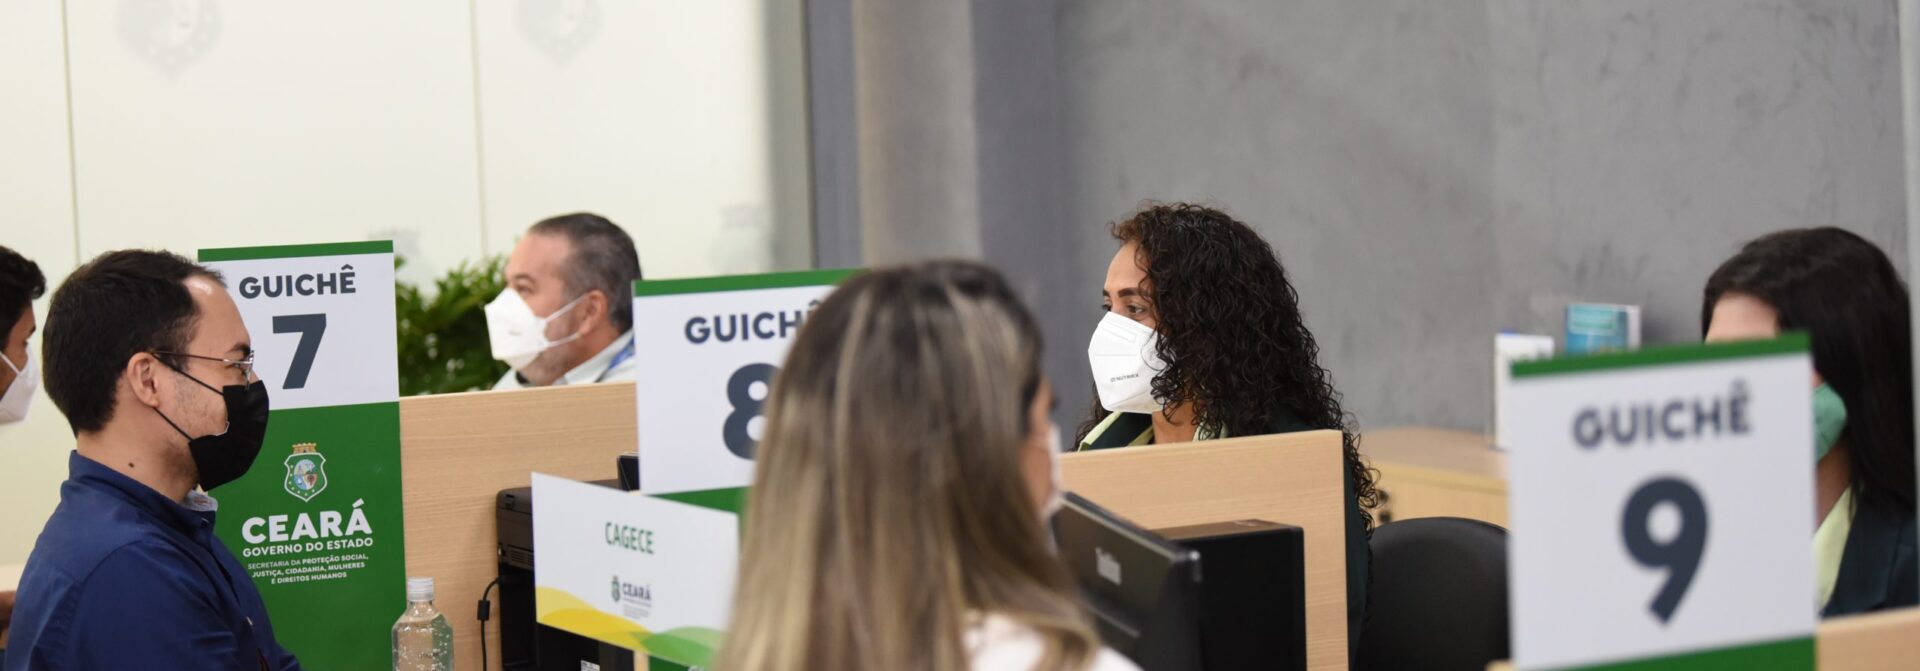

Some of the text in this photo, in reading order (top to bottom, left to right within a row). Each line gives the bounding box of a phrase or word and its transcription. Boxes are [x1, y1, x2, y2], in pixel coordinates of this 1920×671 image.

[239, 264, 356, 299] GUICHÊ
[684, 299, 822, 344] GUICH
[272, 313, 327, 389] 7
[723, 362, 781, 461] 8
[1571, 380, 1751, 450] GUICHÊ
[242, 499, 373, 544] CEARÁ
[605, 522, 653, 554] CAGECE
[242, 537, 374, 557] GOVERNO DO ESTADO
[248, 560, 290, 570] SECRETARIA
[302, 555, 340, 565] PROTEÇÃO
[341, 553, 369, 562] SOCIAL,
[1621, 475, 1708, 627] 9
[252, 562, 365, 578] JUSTIÇA, CIDADANIA, MULHERES
[271, 571, 347, 584] E DIREITOS HUMANOS
[622, 582, 652, 601] CEARÁ
